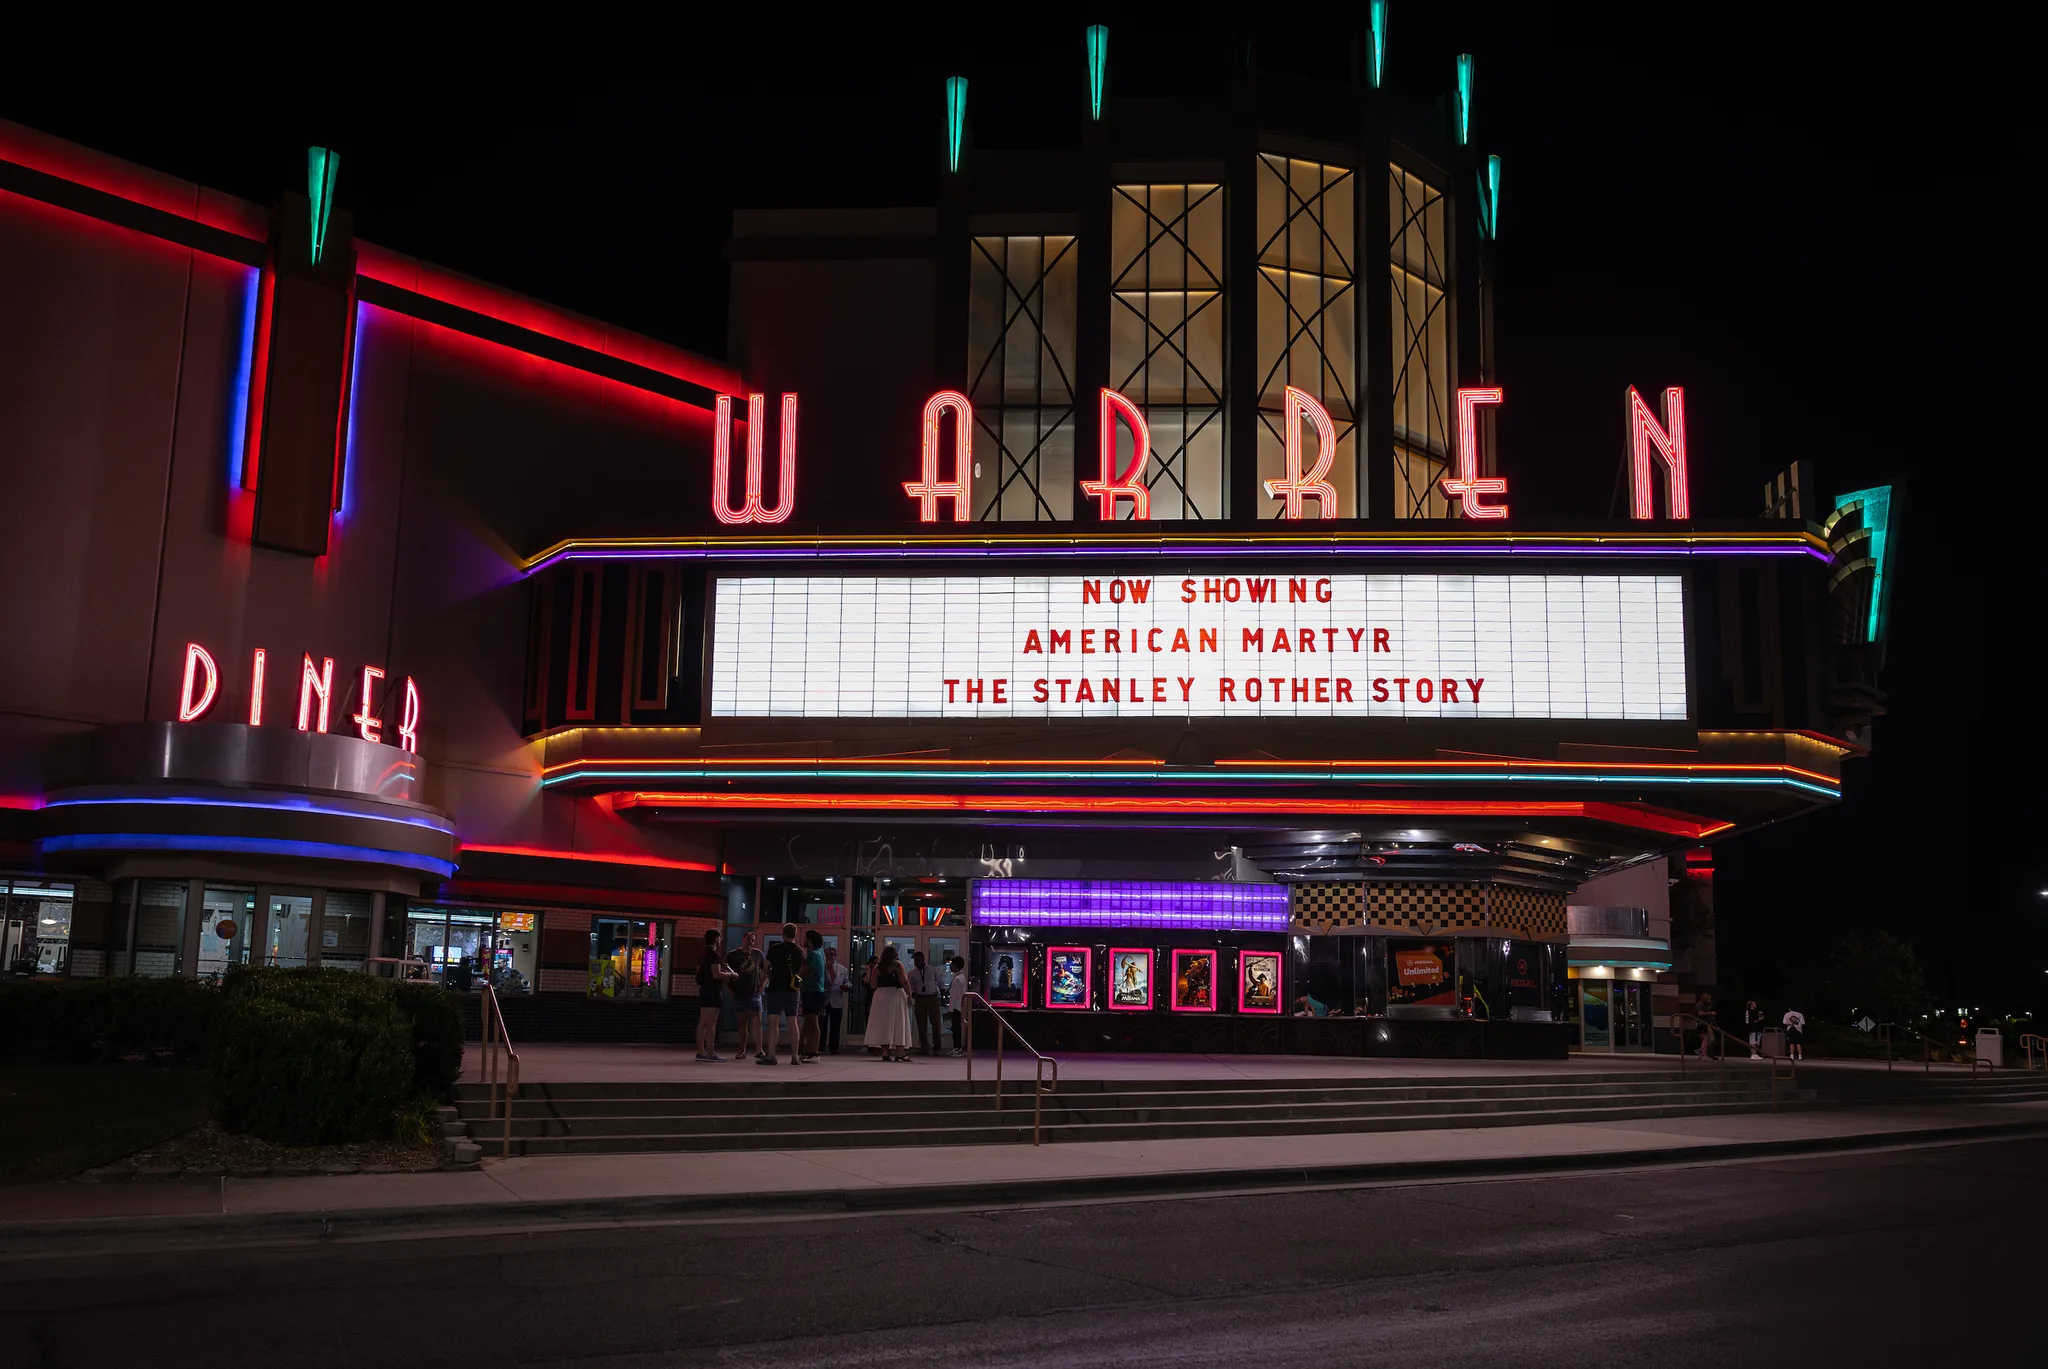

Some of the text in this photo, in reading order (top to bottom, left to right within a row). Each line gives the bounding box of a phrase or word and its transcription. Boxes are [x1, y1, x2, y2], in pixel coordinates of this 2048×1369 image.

[711, 385, 1690, 524] WARREN
[1082, 578, 1333, 604] NOW SHOWING
[1022, 628, 1391, 655] AMERICAN MARTYR
[179, 642, 419, 754] DINER
[943, 677, 1486, 704] THE STANLEY ROTHER STORY
[1403, 966, 1440, 976] Unlimited
